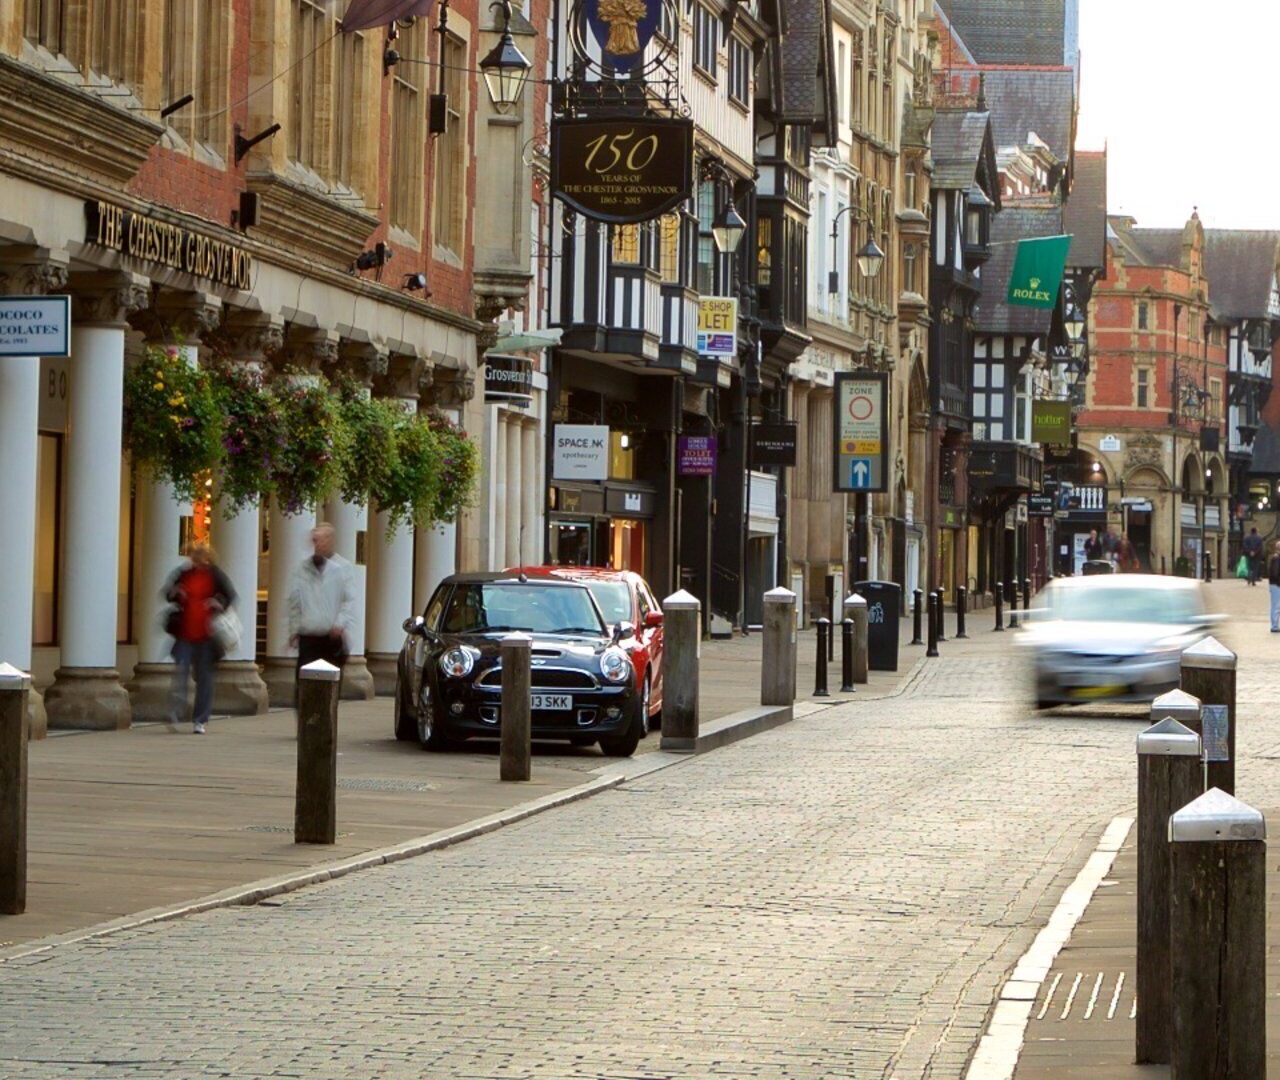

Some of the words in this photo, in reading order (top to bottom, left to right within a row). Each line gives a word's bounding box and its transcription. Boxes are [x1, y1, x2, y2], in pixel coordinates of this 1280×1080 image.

[585, 127, 659, 173] 150
[564, 185, 582, 193] THE
[583, 185, 622, 193] CHESTER
[624, 185, 678, 193] GROSVENOR
[98, 201, 124, 251] THE
[128, 213, 183, 269] CHESTER
[186, 232, 253, 291] GROSVENOR
[1013, 289, 1051, 301] ROLEX
[709, 301, 732, 312] SHOP
[705, 313, 730, 329] LET
[49, 369, 67, 400] BO
[545, 696, 568, 708] SKK
